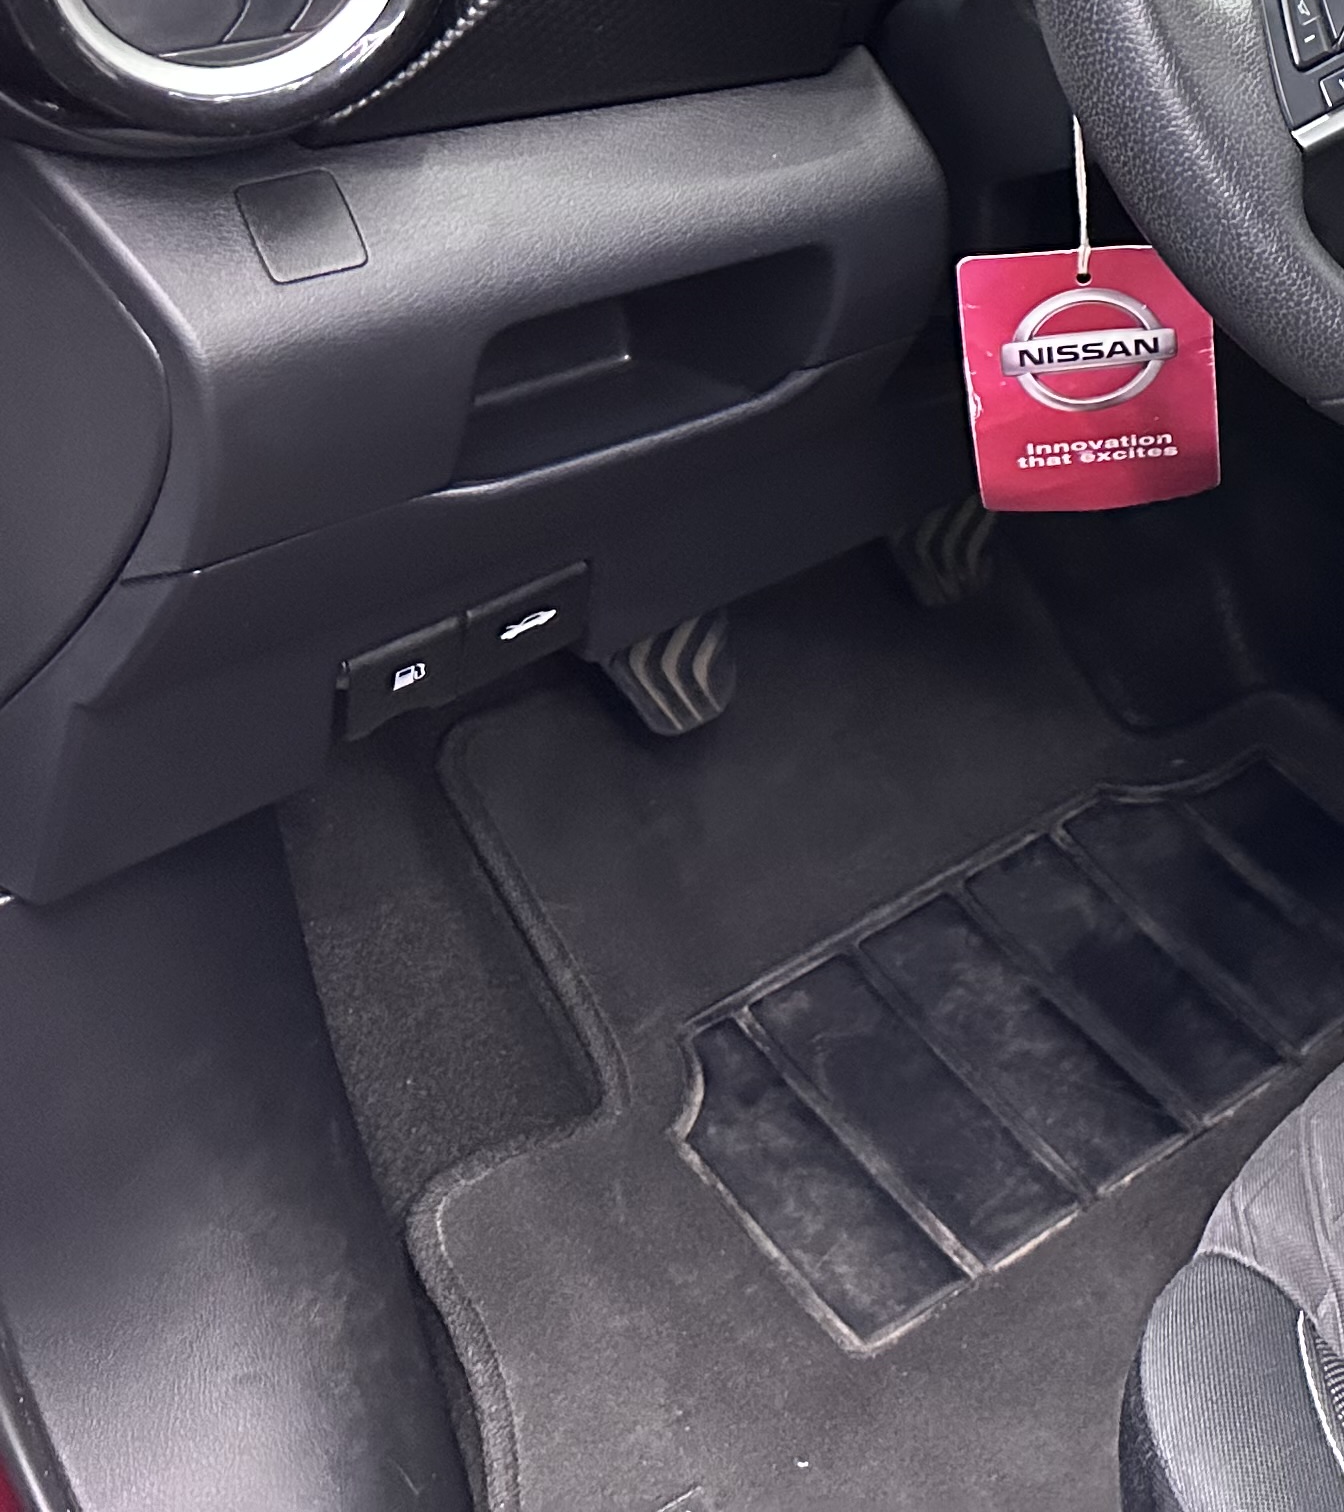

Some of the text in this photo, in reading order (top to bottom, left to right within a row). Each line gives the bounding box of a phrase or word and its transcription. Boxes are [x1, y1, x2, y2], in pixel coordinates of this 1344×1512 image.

[1018, 336, 1160, 368] NISSAN
[1026, 433, 1173, 456] Innovation
[1017, 446, 1179, 469] that excites
